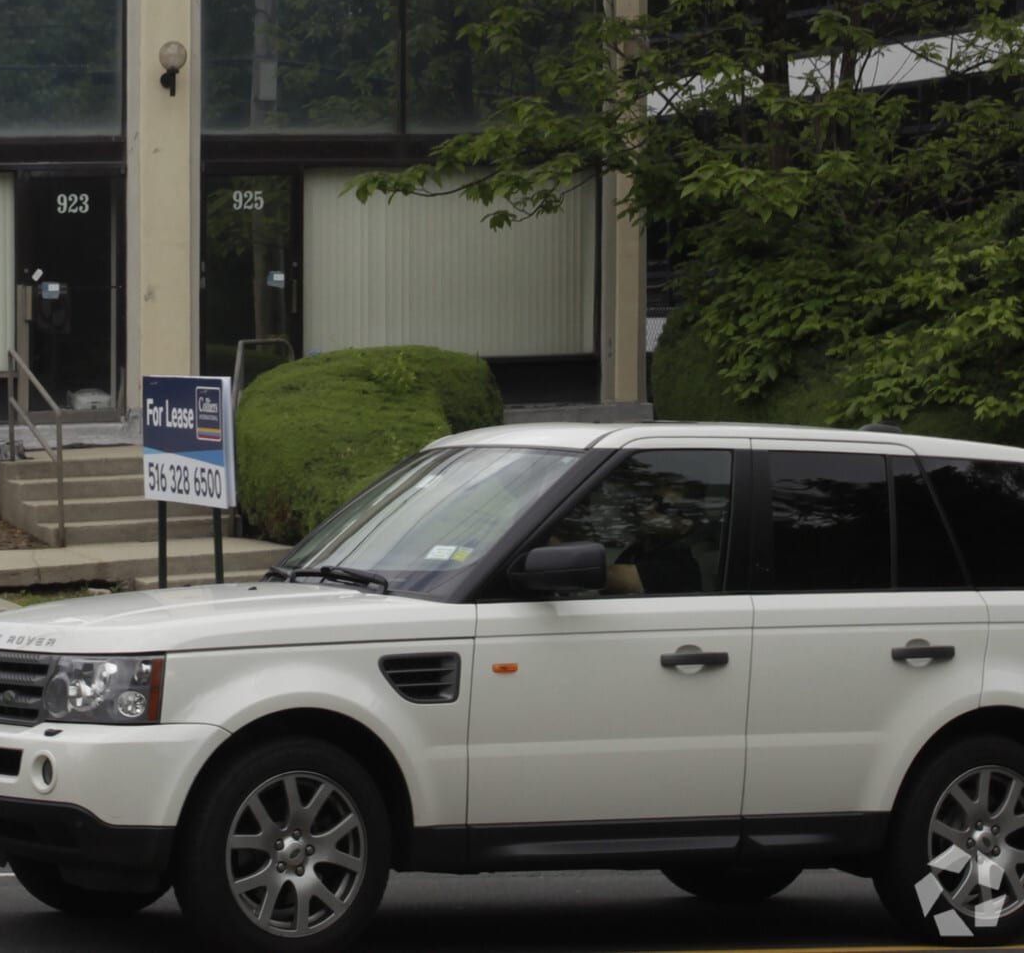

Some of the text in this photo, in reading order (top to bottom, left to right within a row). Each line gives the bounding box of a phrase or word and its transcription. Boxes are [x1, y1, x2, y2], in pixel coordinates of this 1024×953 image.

[57, 193, 90, 214] 923
[232, 190, 264, 211] 925
[146, 398, 194, 430] For Lease
[148, 462, 222, 499] 516 328 6500
[6, 634, 57, 647] ROVER
